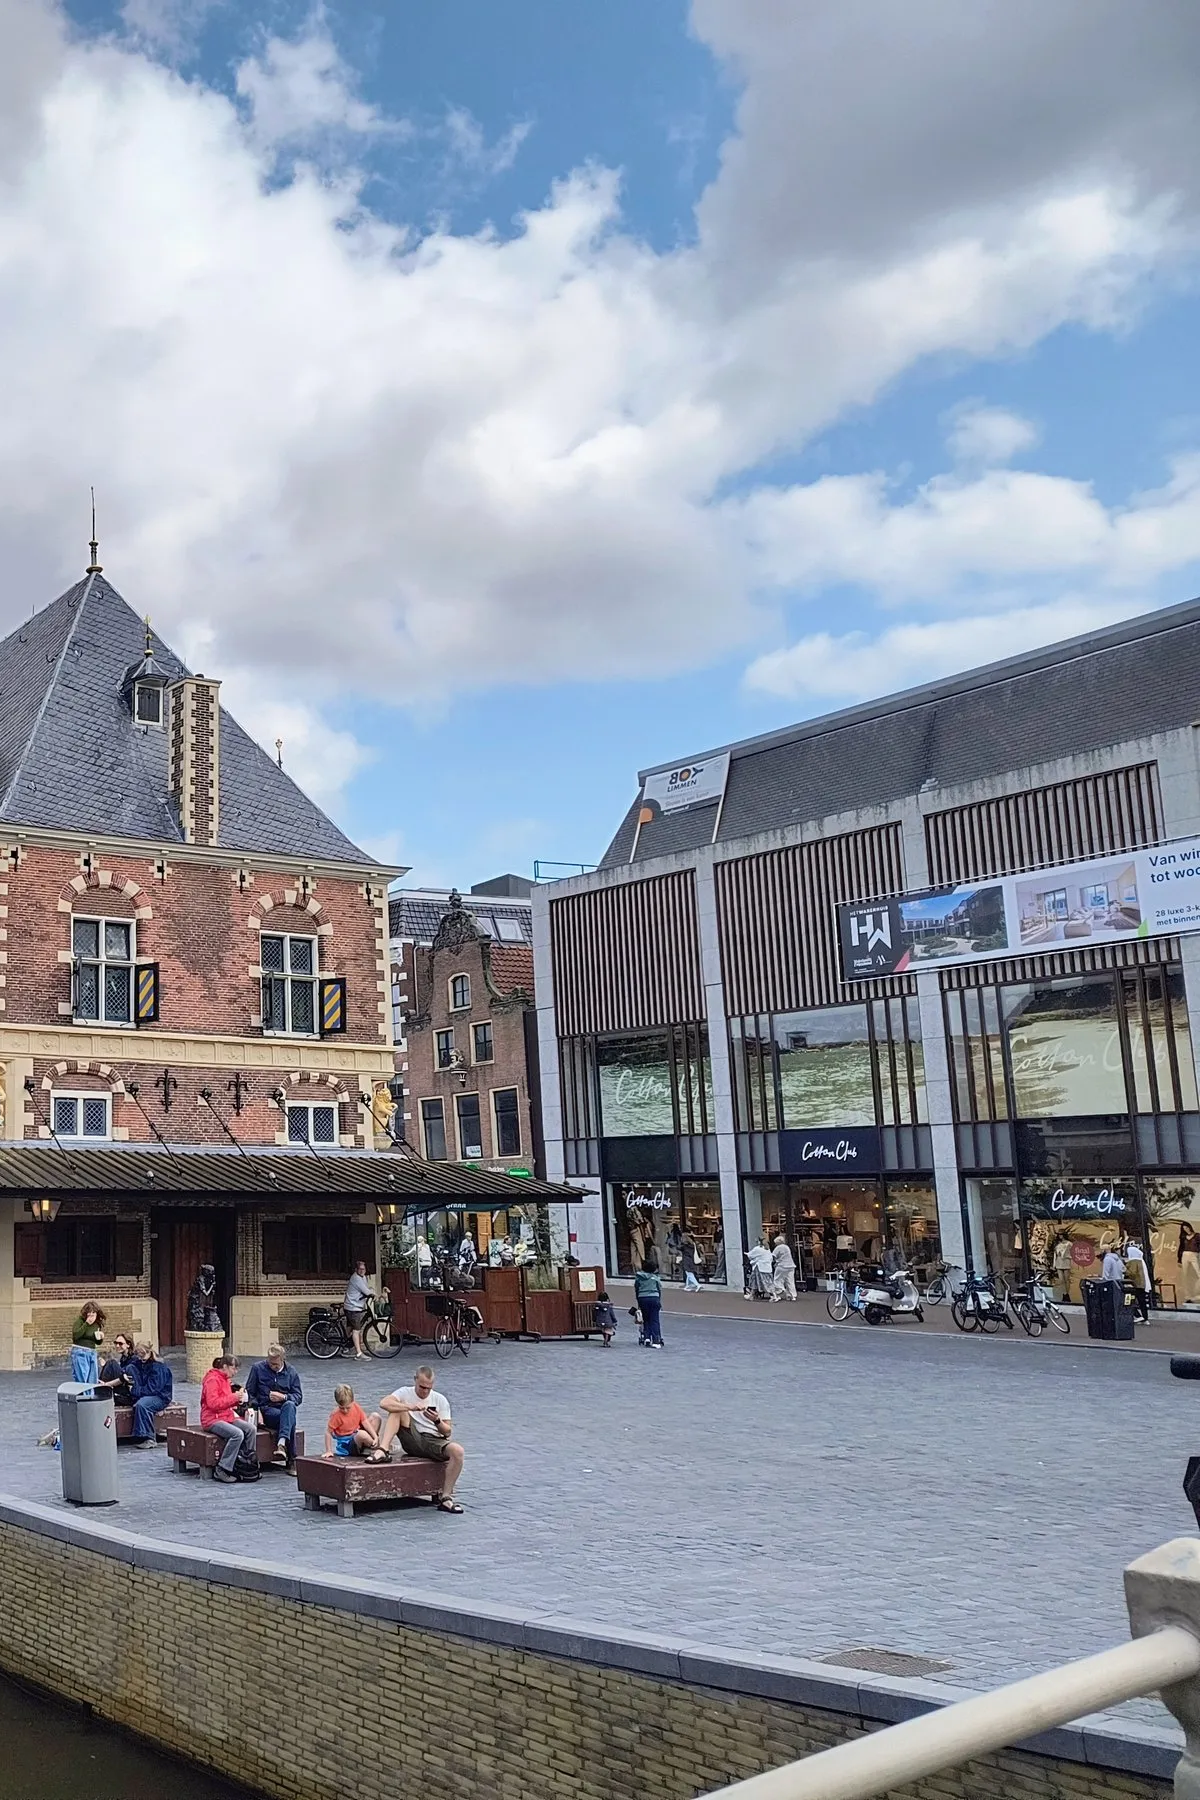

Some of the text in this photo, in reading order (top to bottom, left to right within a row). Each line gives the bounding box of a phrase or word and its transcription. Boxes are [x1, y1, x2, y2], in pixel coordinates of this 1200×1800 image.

[667, 779, 697, 793] LIMMEN
[1149, 855, 1176, 867] Van
[1151, 870, 1170, 883] tot
[1156, 909, 1166, 917] 28
[1156, 918, 1172, 926] met
[802, 1140, 857, 1161] Cotton Club
[626, 1191, 671, 1210] Cotton Club
[1051, 1189, 1126, 1214] Cotton Club
[1149, 1231, 1177, 1255] Club
